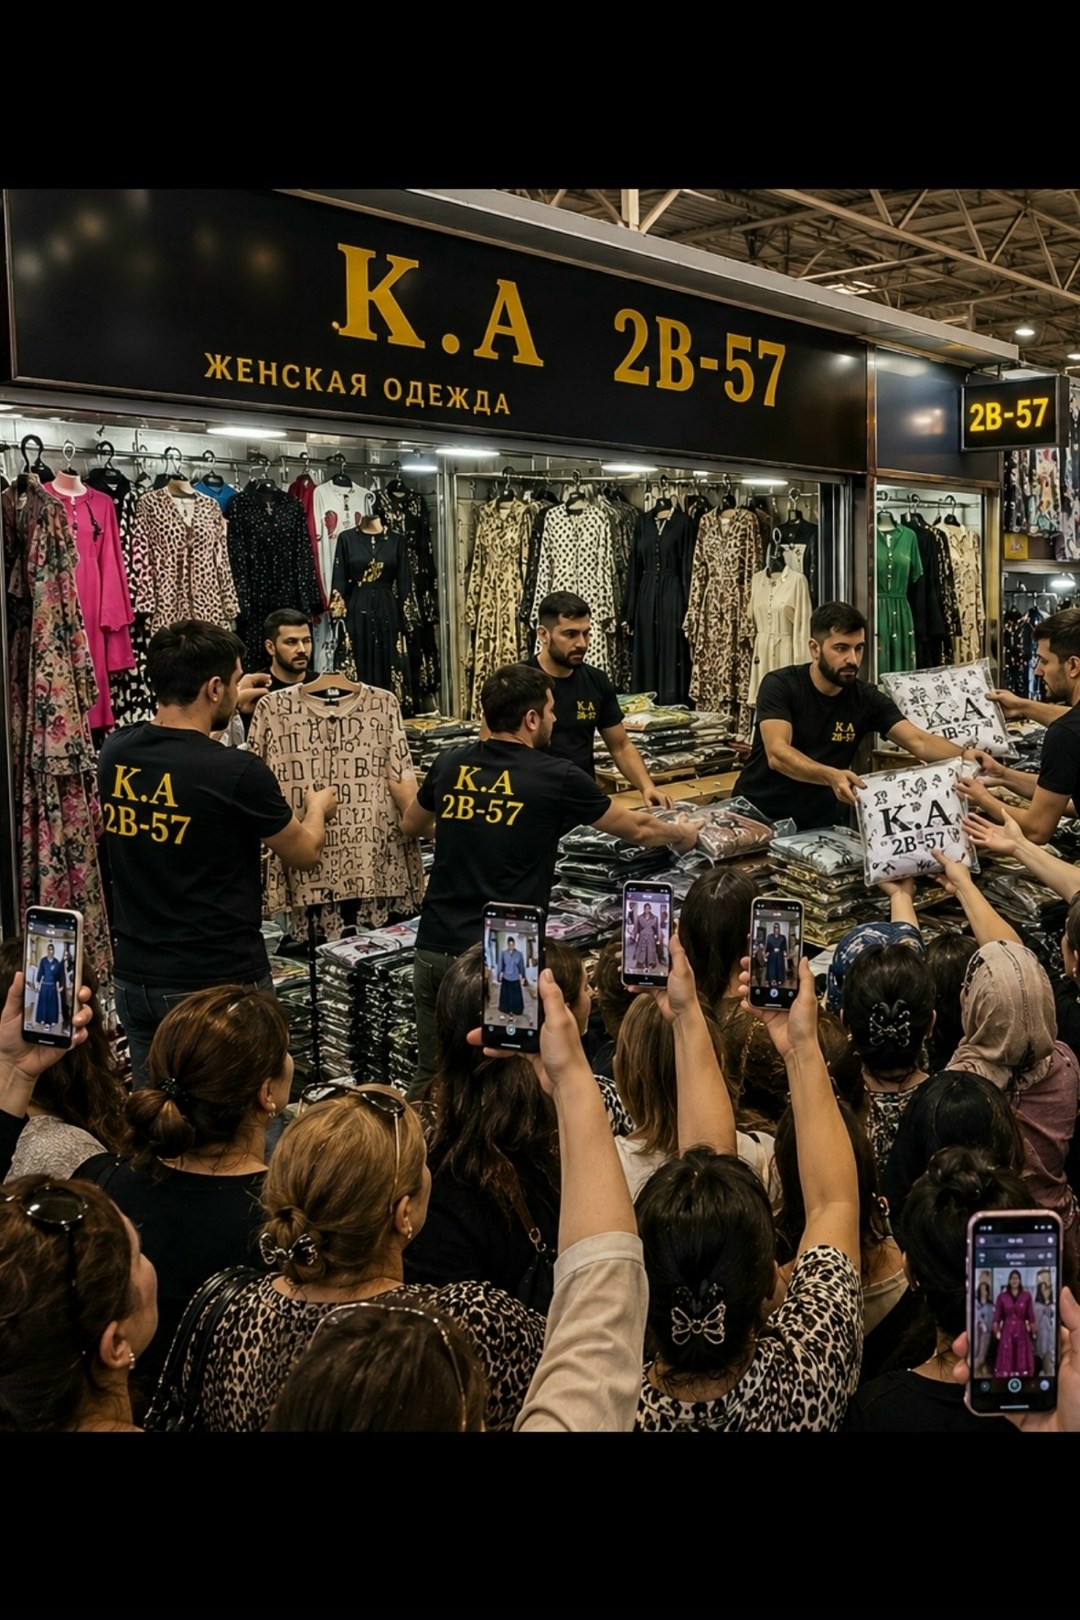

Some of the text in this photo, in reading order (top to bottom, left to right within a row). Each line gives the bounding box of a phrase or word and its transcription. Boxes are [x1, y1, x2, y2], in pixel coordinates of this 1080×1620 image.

[337, 243, 786, 407] K.A 2B-57
[204, 352, 510, 416] ЖЕНСКАЯ ОДЕЖДА
[969, 397, 1049, 432] 2B-57
[112, 764, 178, 807] K.A
[453, 765, 514, 795] K.A
[104, 803, 191, 844] 2B-57
[441, 794, 524, 825] 2B-57
[879, 800, 953, 837] K.A
[892, 831, 945, 856] 2B-57
